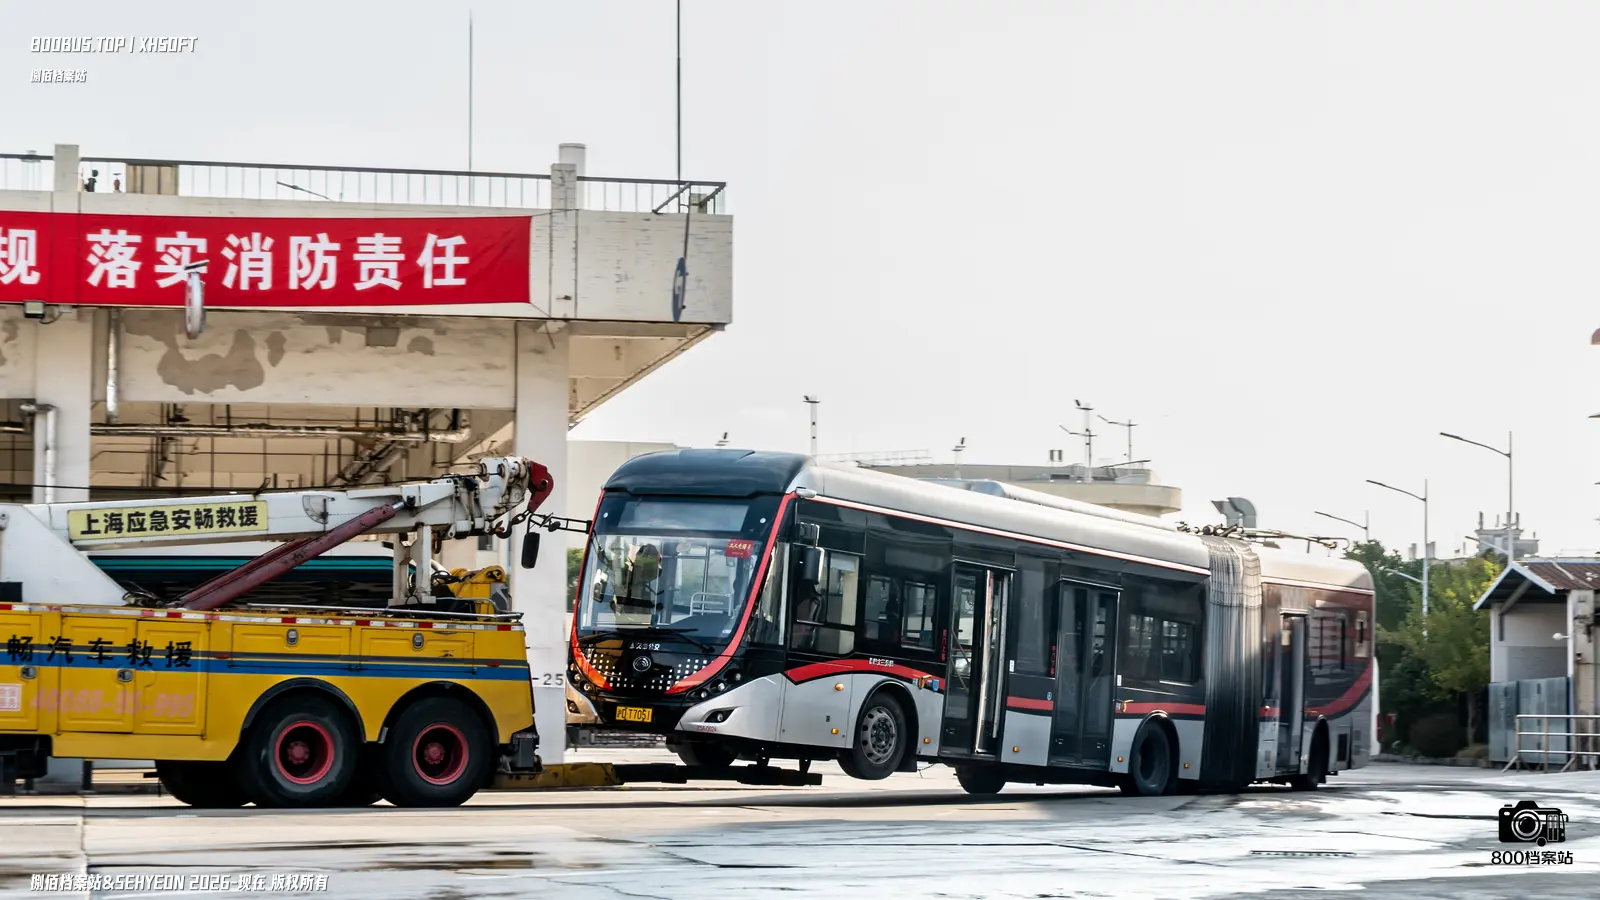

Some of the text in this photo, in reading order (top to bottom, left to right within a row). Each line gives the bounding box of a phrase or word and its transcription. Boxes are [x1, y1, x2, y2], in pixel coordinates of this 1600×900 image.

[86, 229, 469, 291] 落实消防责任
[80, 505, 259, 535] 上海应急安畅救援
[7, 634, 193, 668] 畅汽车救援
[29, 687, 195, 718] 40088-95-995
